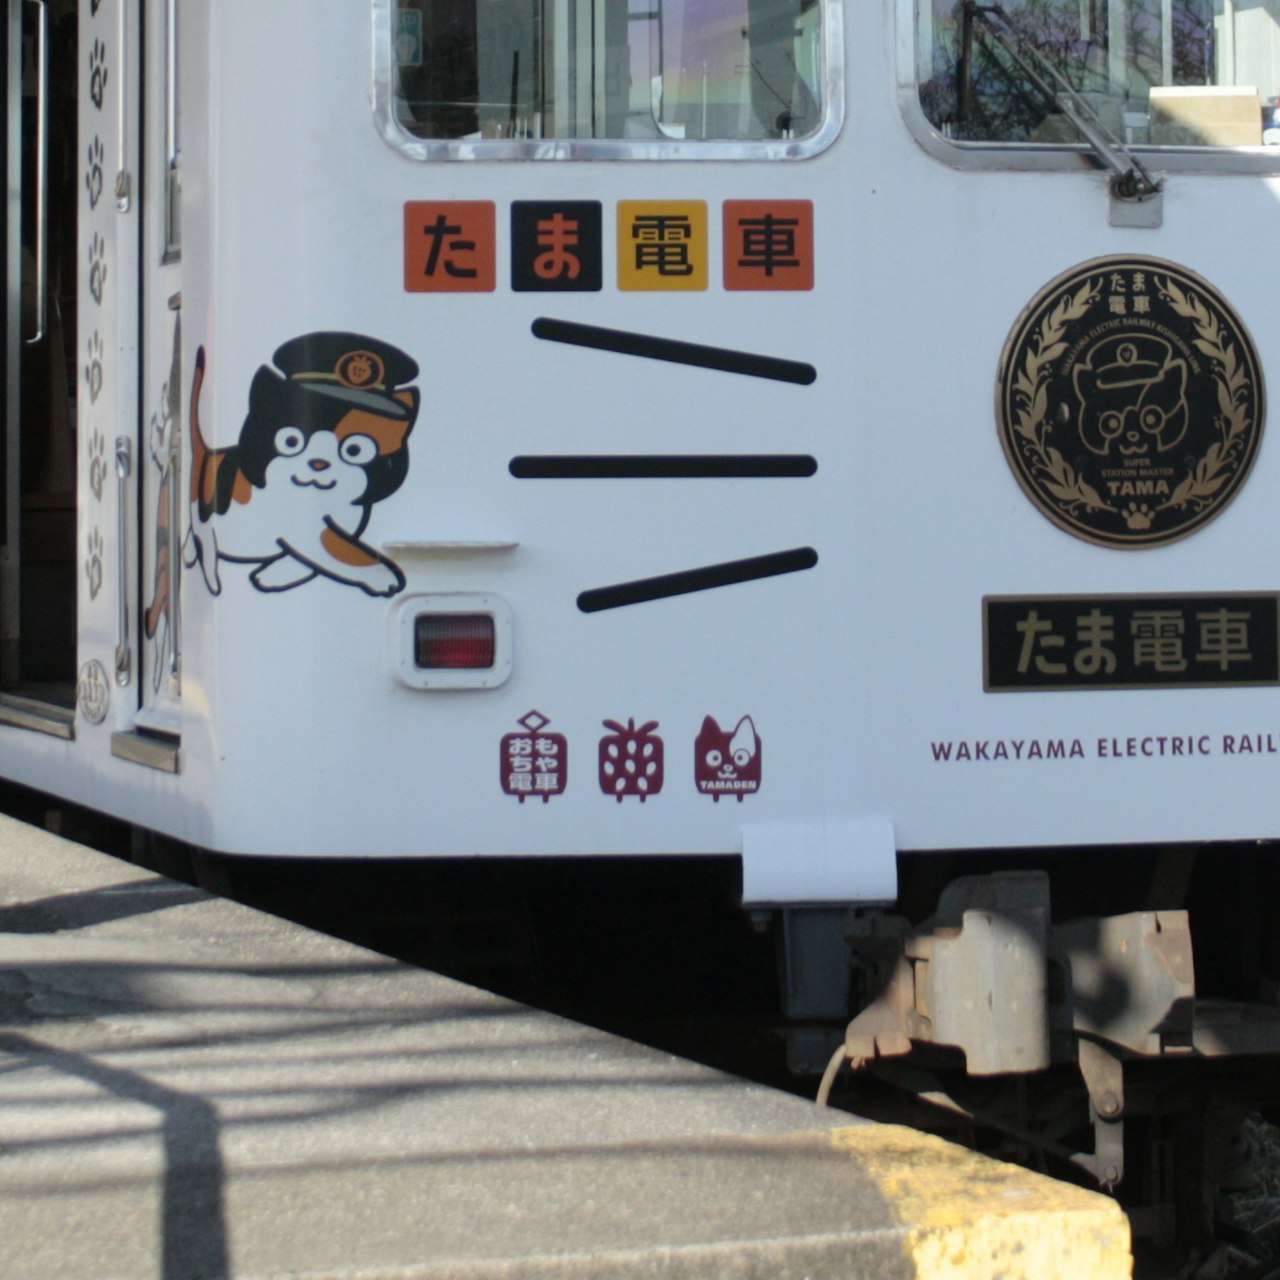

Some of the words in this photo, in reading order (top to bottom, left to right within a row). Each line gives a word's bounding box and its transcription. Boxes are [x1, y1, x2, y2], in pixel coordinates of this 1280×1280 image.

[423, 212, 801, 280] たま電車
[1109, 271, 1147, 293] たま
[1108, 294, 1151, 315] 電車
[1123, 458, 1152, 468] SUPER
[1106, 480, 1170, 496] TAMA
[1015, 607, 1253, 675] たま電車
[930, 738, 1085, 762] WAKAYAMA
[1097, 734, 1212, 758] ELECTRIC
